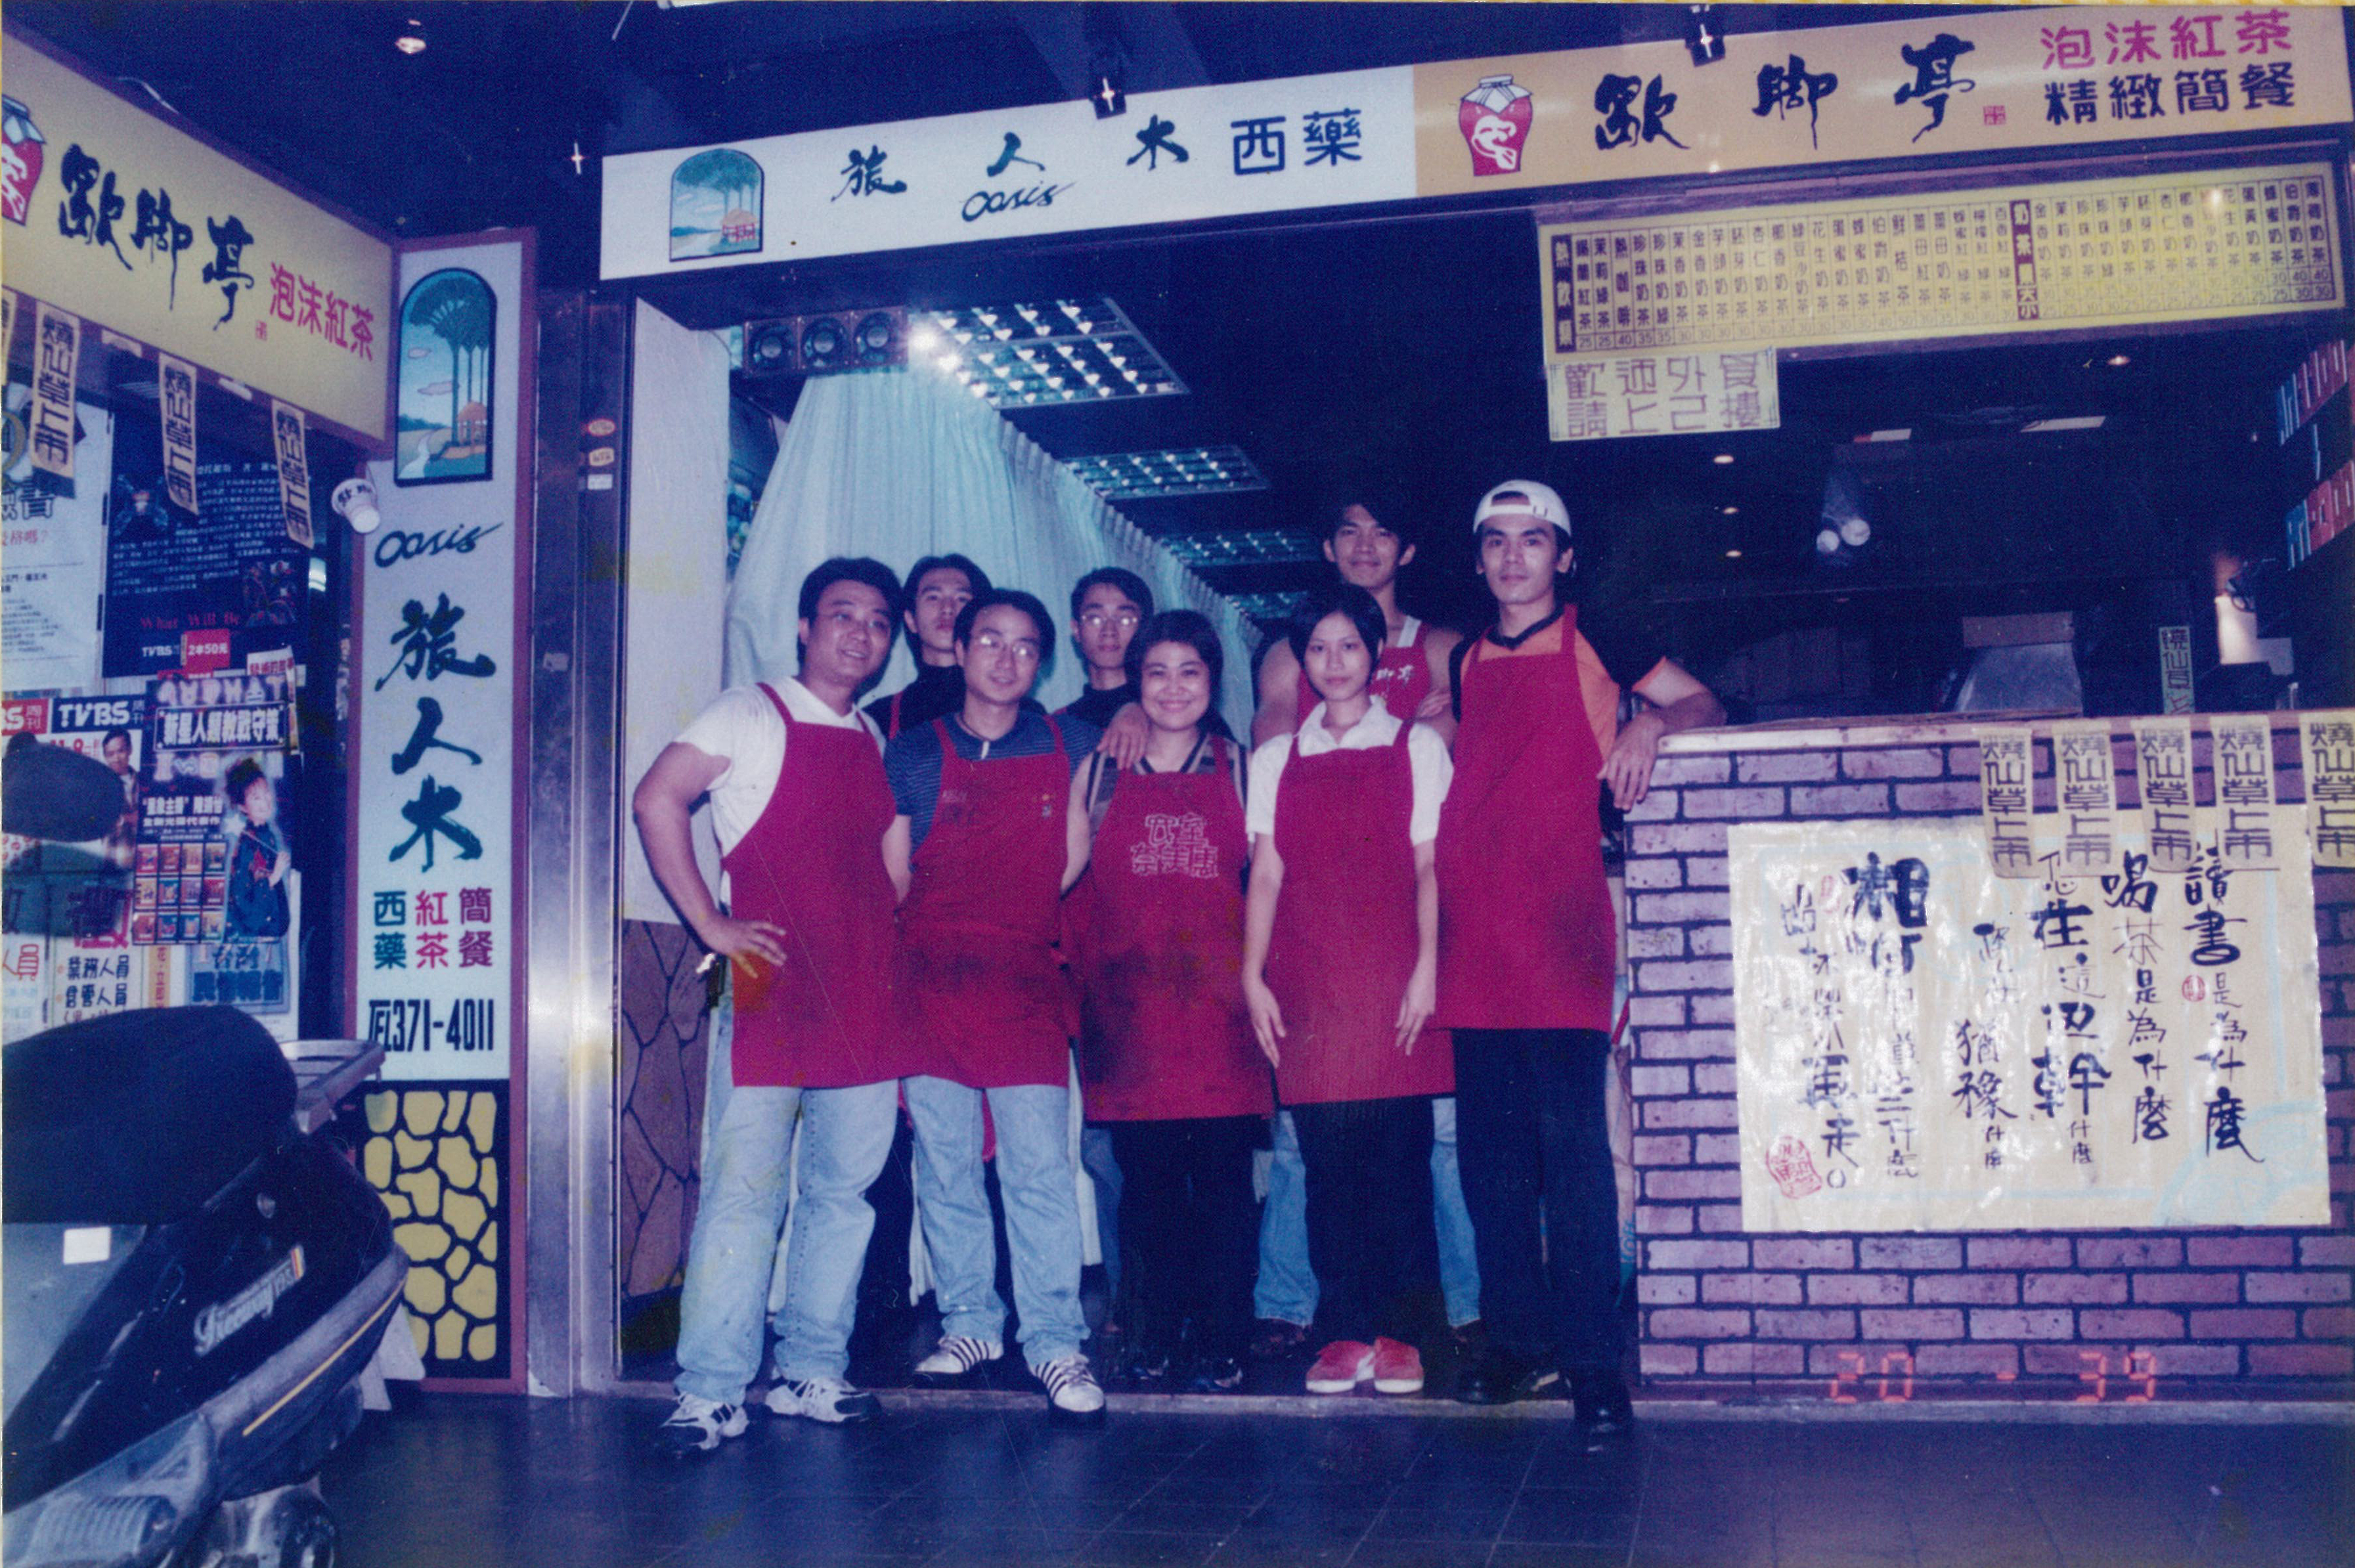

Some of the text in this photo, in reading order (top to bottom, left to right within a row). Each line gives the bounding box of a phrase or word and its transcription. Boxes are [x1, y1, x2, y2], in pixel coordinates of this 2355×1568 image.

[2040, 9, 2291, 70] 泡沫紅茶
[2045, 62, 2294, 125] 精緻簡餐
[1231, 108, 1361, 175] 西藥
[2272, 273, 2285, 282] 30
[2293, 271, 2307, 280] 40
[2315, 270, 2329, 279] 40
[2274, 290, 2287, 299] 25
[2295, 288, 2309, 297] 30
[2317, 286, 2331, 296] 30
[270, 262, 374, 362] 泡沫紅茶
[1579, 336, 1593, 349] 25
[1599, 334, 1612, 347] 25
[1619, 333, 1632, 345] 40
[1639, 332, 1652, 344] 35
[1659, 330, 1671, 343] 35
[58, 701, 131, 728] TVBS
[374, 890, 407, 969] 西藥
[415, 890, 449, 969] 紅茶
[458, 886, 494, 969] 簡餐
